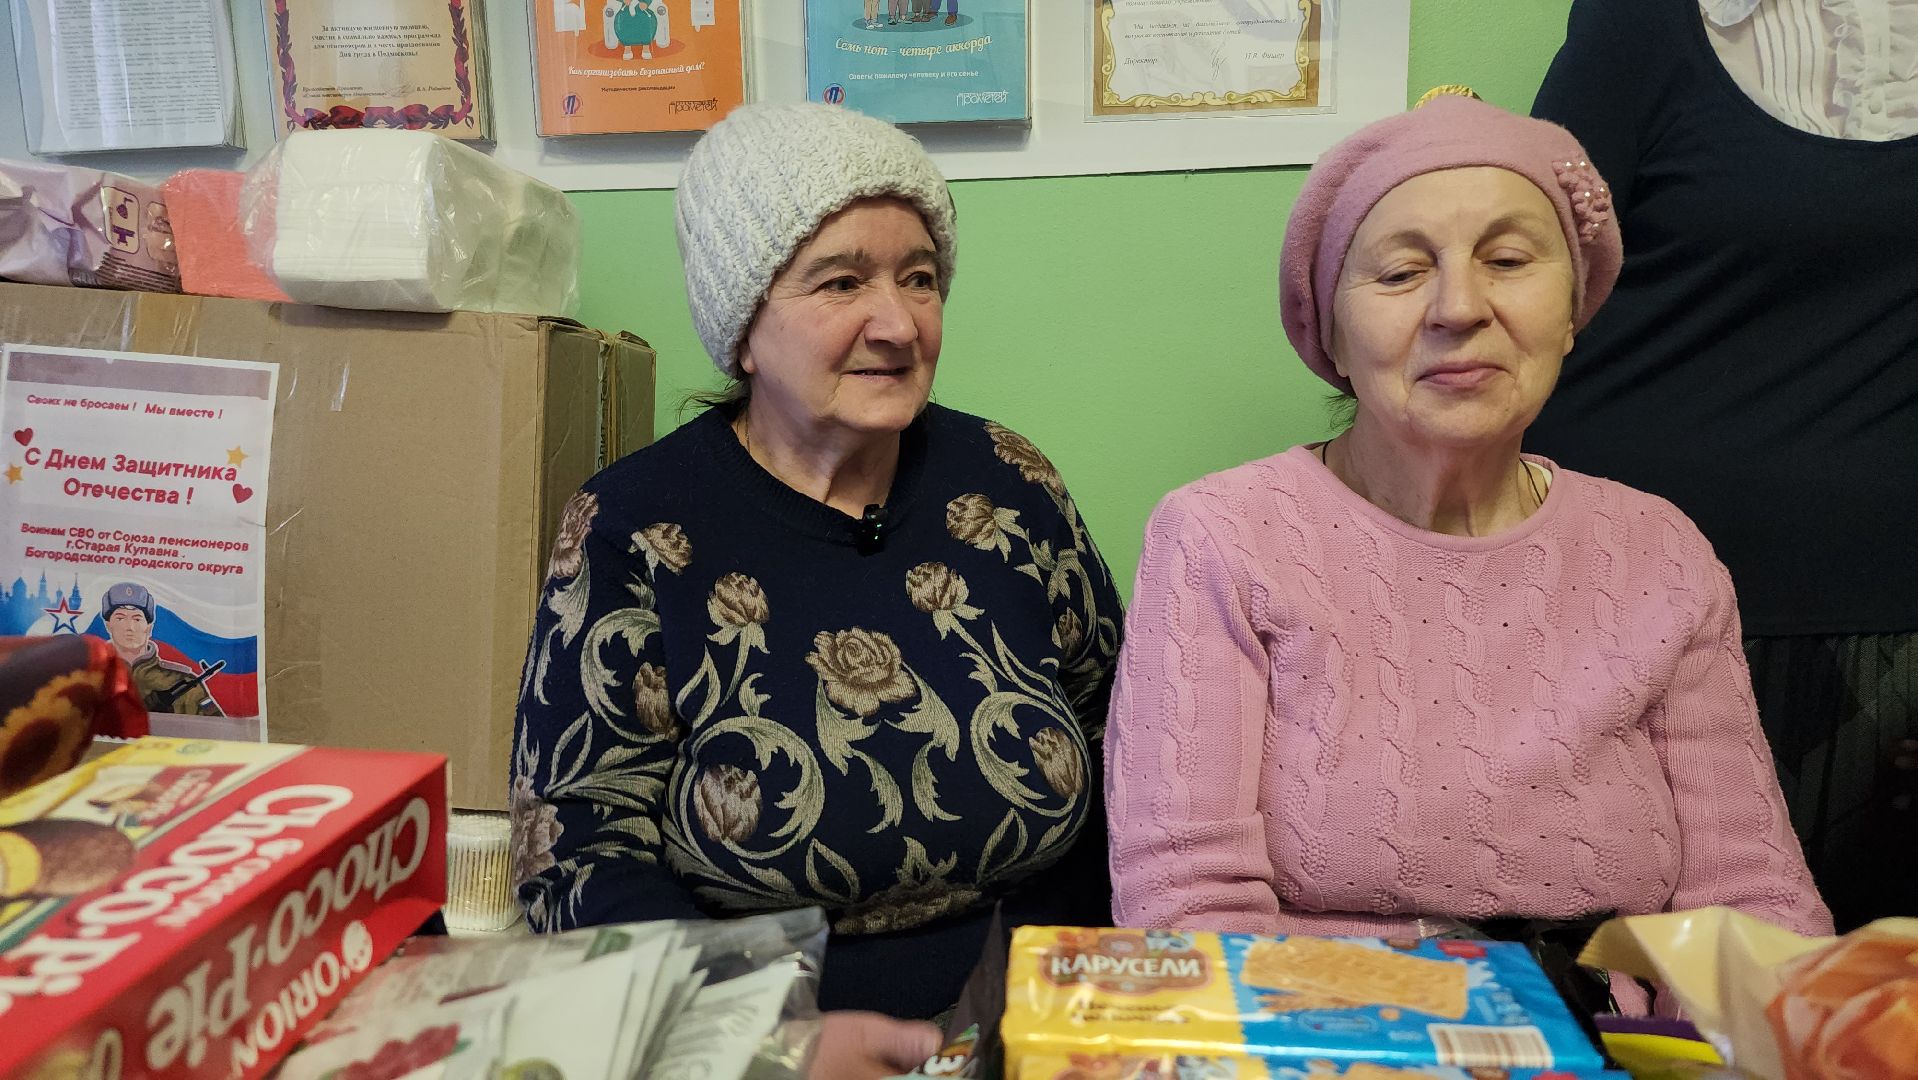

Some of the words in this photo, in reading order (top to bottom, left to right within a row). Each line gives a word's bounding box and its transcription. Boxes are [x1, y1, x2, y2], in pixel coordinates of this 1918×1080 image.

[835, 37, 862, 53] Семь
[863, 45, 889, 56] нот
[899, 45, 942, 61] четыре
[945, 35, 993, 54] аккорда
[27, 394, 62, 407] Своих
[63, 398, 78, 407] не
[80, 398, 130, 412] бросаем
[144, 403, 166, 416] Мы
[169, 406, 215, 419] вместе
[24, 447, 41, 466] С
[44, 448, 106, 471] Днем
[112, 454, 237, 482] Защитника
[63, 477, 180, 505] Отечества
[21, 523, 66, 537] Воинам
[69, 527, 95, 540] СВО
[98, 531, 111, 541] от
[113, 530, 155, 545] Союза
[159, 536, 249, 553] пенсионеров
[124, 543, 179, 559] Купавна
[25, 546, 116, 567] Богородского
[118, 554, 194, 572] городского
[197, 561, 244, 575] округа
[1051, 953, 1200, 977] КАРУСЕЛИ
[230, 951, 340, 1080] ORION
